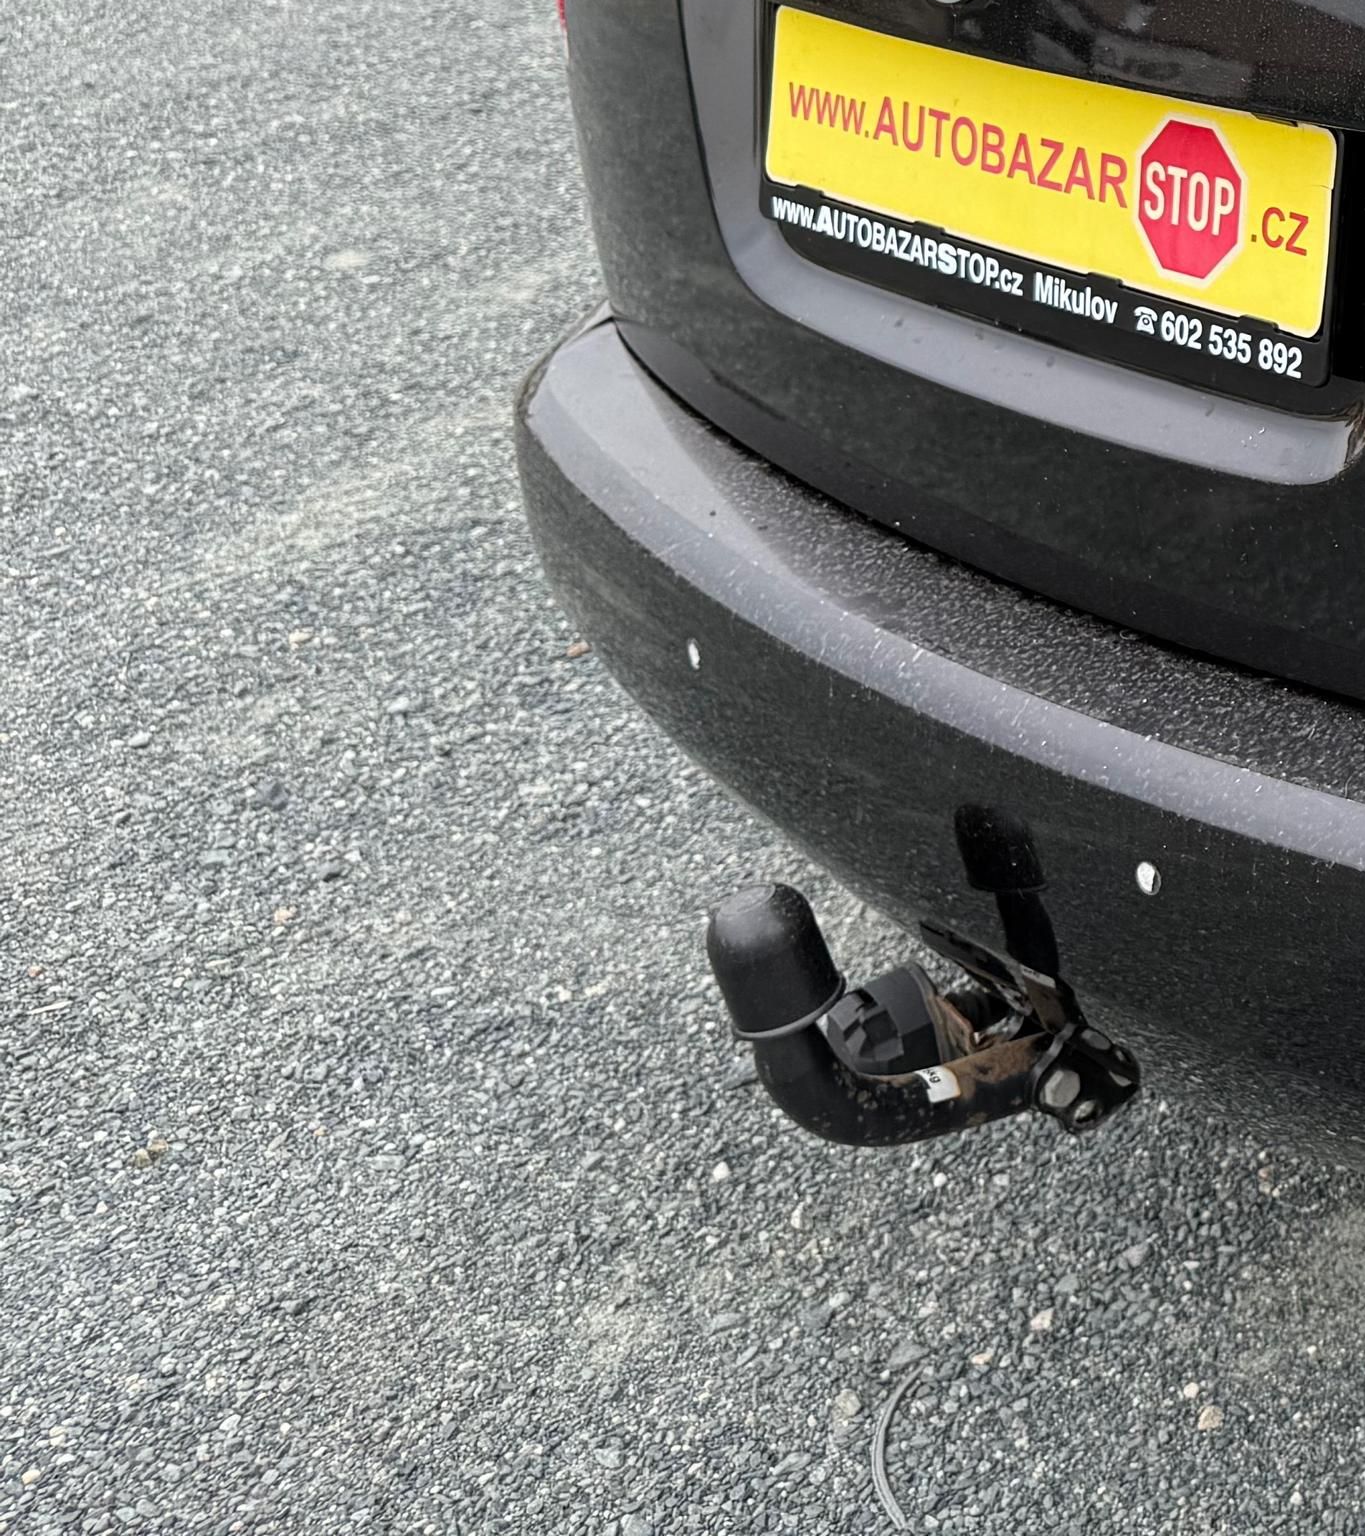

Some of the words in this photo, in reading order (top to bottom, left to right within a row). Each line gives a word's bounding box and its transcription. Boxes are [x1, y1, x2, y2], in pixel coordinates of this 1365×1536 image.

[1033, 271, 1119, 324] Mikulov
[1160, 310, 1203, 350] 602
[1208, 324, 1252, 364] 535
[1257, 337, 1303, 379] 892
